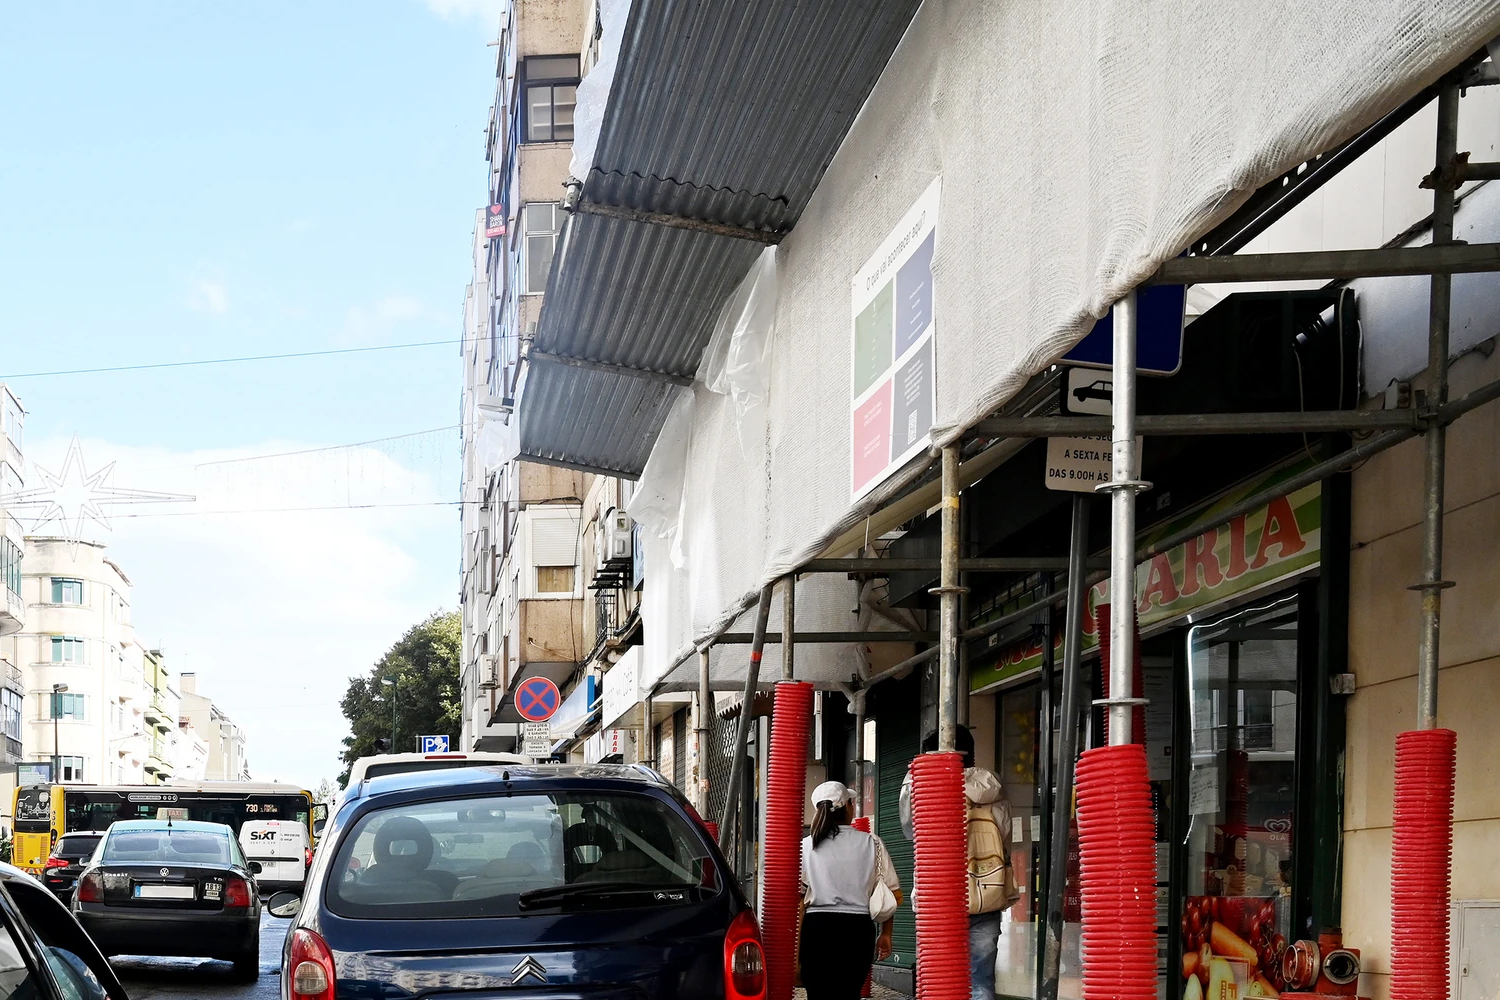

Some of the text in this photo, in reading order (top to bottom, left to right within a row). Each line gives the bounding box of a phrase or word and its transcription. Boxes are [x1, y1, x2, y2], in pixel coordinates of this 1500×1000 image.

[1064, 449, 1112, 462] A SEXTA FE
[1049, 468, 1109, 481] DAS 9.00H ÀS
[425, 738, 435, 752] P
[245, 804, 258, 813] 730
[205, 883, 222, 891] 1813
